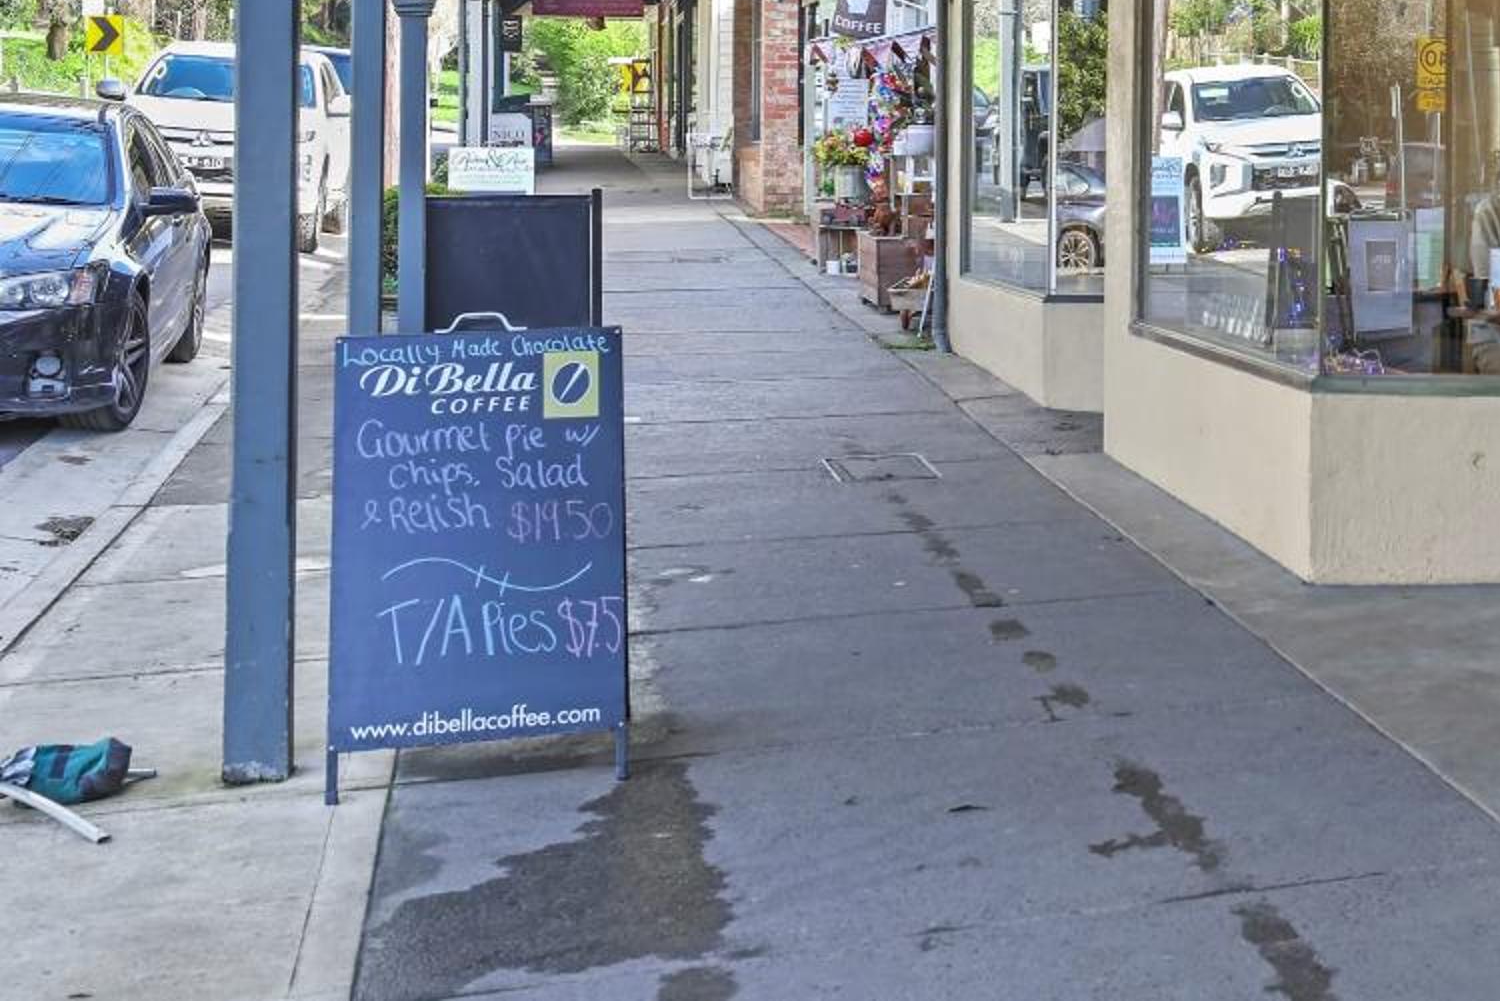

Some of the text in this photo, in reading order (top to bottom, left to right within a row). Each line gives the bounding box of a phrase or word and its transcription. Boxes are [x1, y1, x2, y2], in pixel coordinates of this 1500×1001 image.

[835, 14, 882, 34] COFFEE
[343, 334, 609, 367] Locally Made Chocolate
[360, 362, 539, 397] Di Bella
[431, 395, 531, 415] COFFEE
[357, 419, 490, 459] Gourmet
[565, 424, 601, 447] w/
[496, 453, 588, 489] Salad
[390, 493, 489, 533] Relish
[482, 599, 556, 656] Pies
[350, 704, 601, 740] www.dibellacoffee.com
